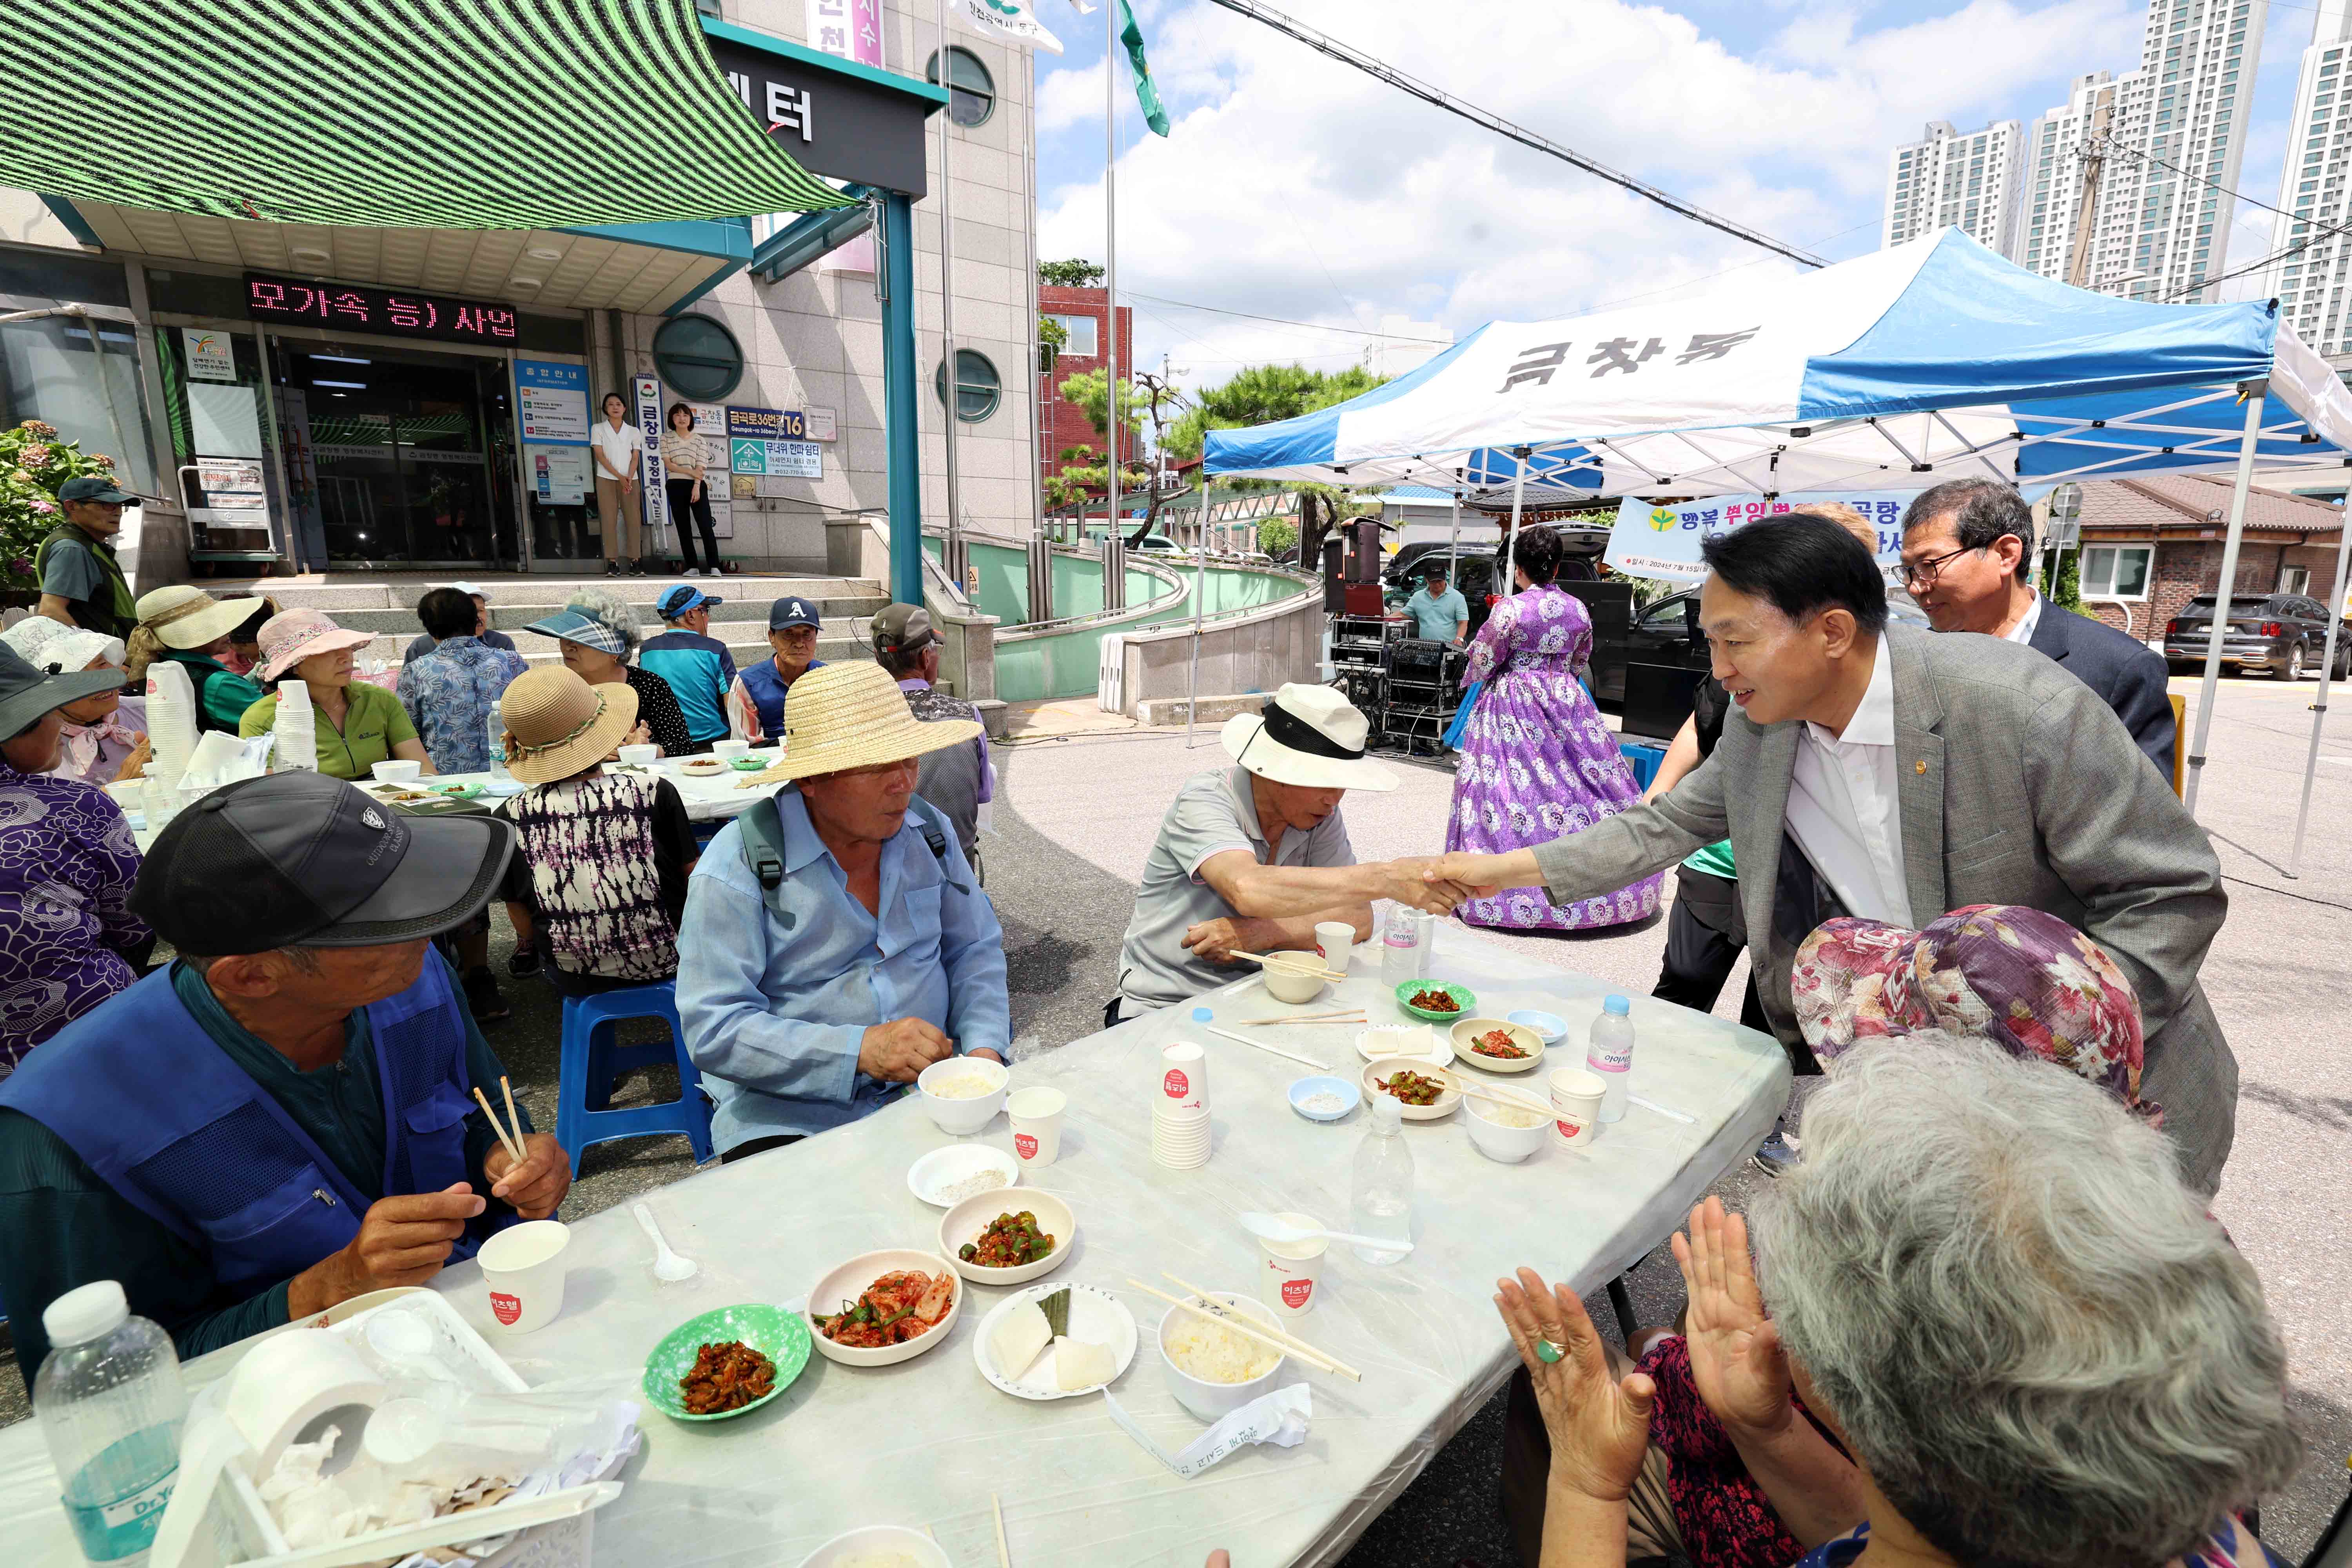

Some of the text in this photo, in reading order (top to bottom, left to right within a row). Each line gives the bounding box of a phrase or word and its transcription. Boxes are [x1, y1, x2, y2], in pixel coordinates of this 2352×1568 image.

[1019, 22, 1038, 34] 동구
[1495, 325, 1762, 394] 금창동
[643, 406, 659, 450] 금창동
[785, 416, 802, 436] 16
[805, 445, 819, 456] 쉼터
[1650, 561, 1671, 569] 2024년
[788, 602, 807, 618] A
[1016, 1138, 1035, 1149] 이츠웰
[1284, 1284, 1310, 1295] 이츠웰
[491, 1298, 517, 1310] 이츠웰
[1229, 1426, 1258, 1448] 맛있게
[1197, 1445, 1224, 1468] 드시고
